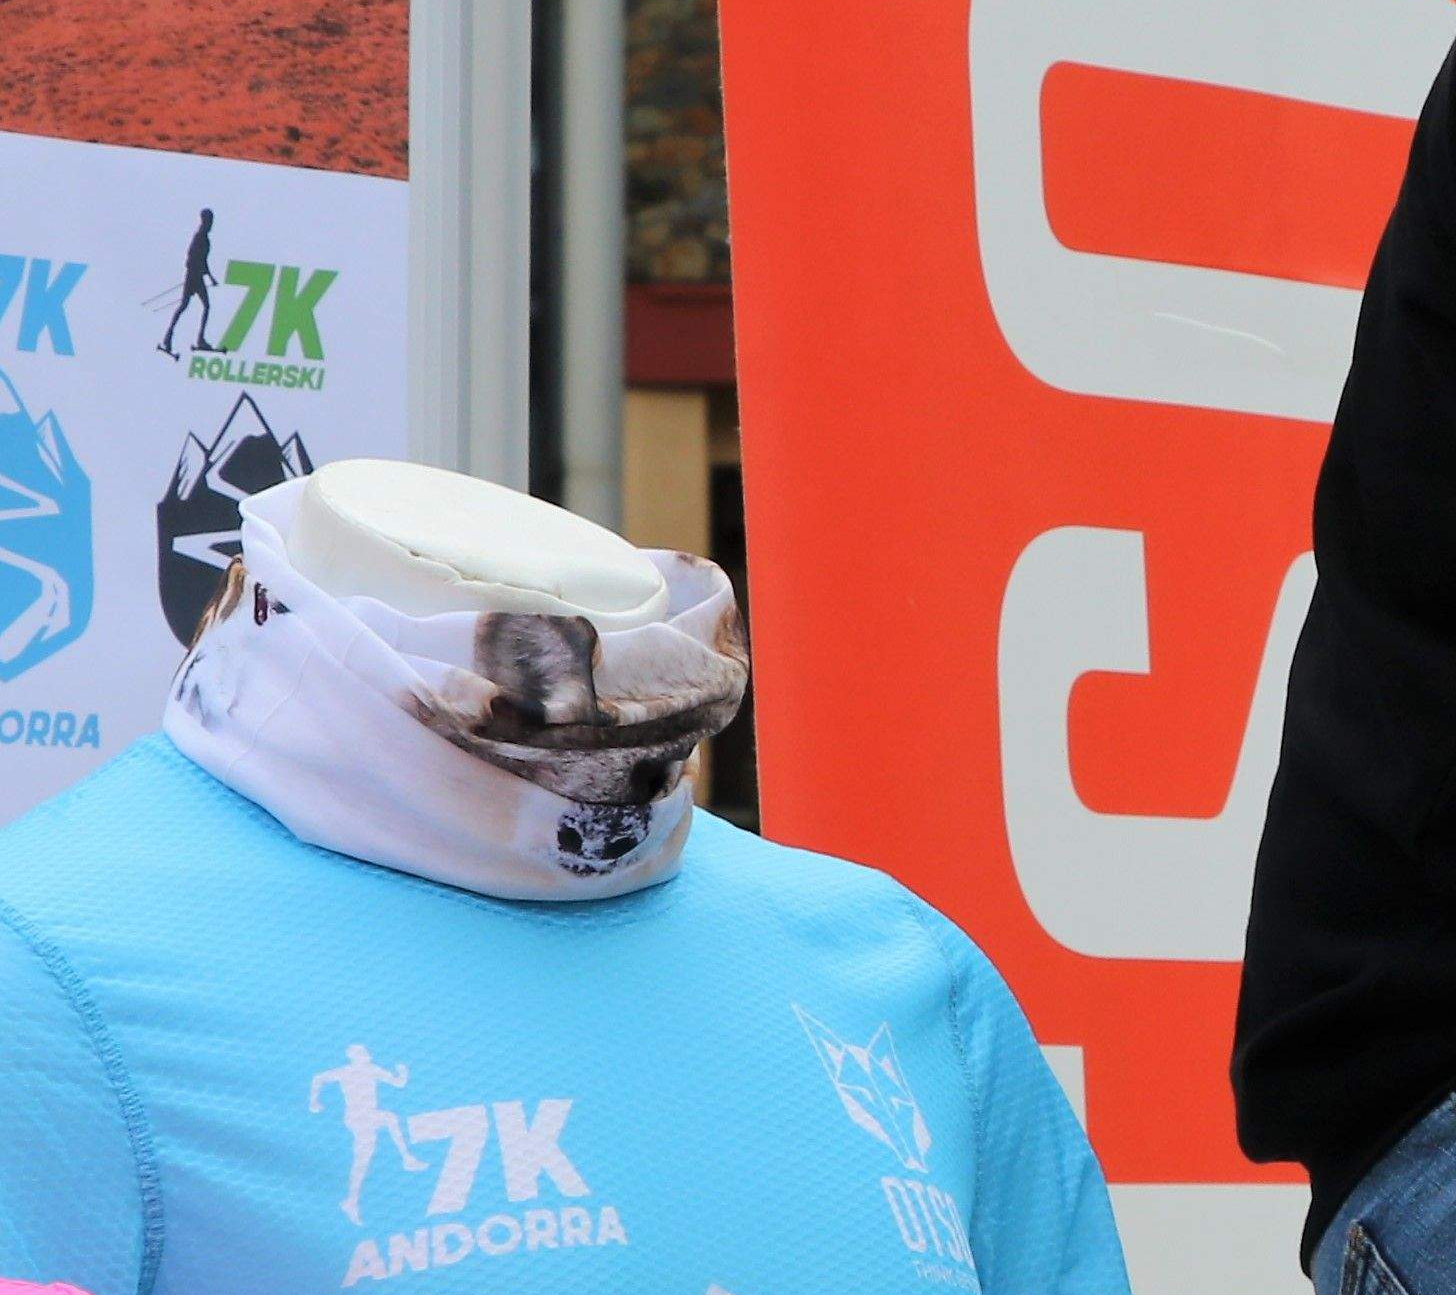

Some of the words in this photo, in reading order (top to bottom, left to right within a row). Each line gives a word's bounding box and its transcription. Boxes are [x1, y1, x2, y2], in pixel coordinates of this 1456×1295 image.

[217, 259, 339, 361] 7K
[187, 356, 325, 391] ROLLERSKI
[407, 1099, 592, 1218] 7K
[340, 1205, 628, 1288] ANDORRA
